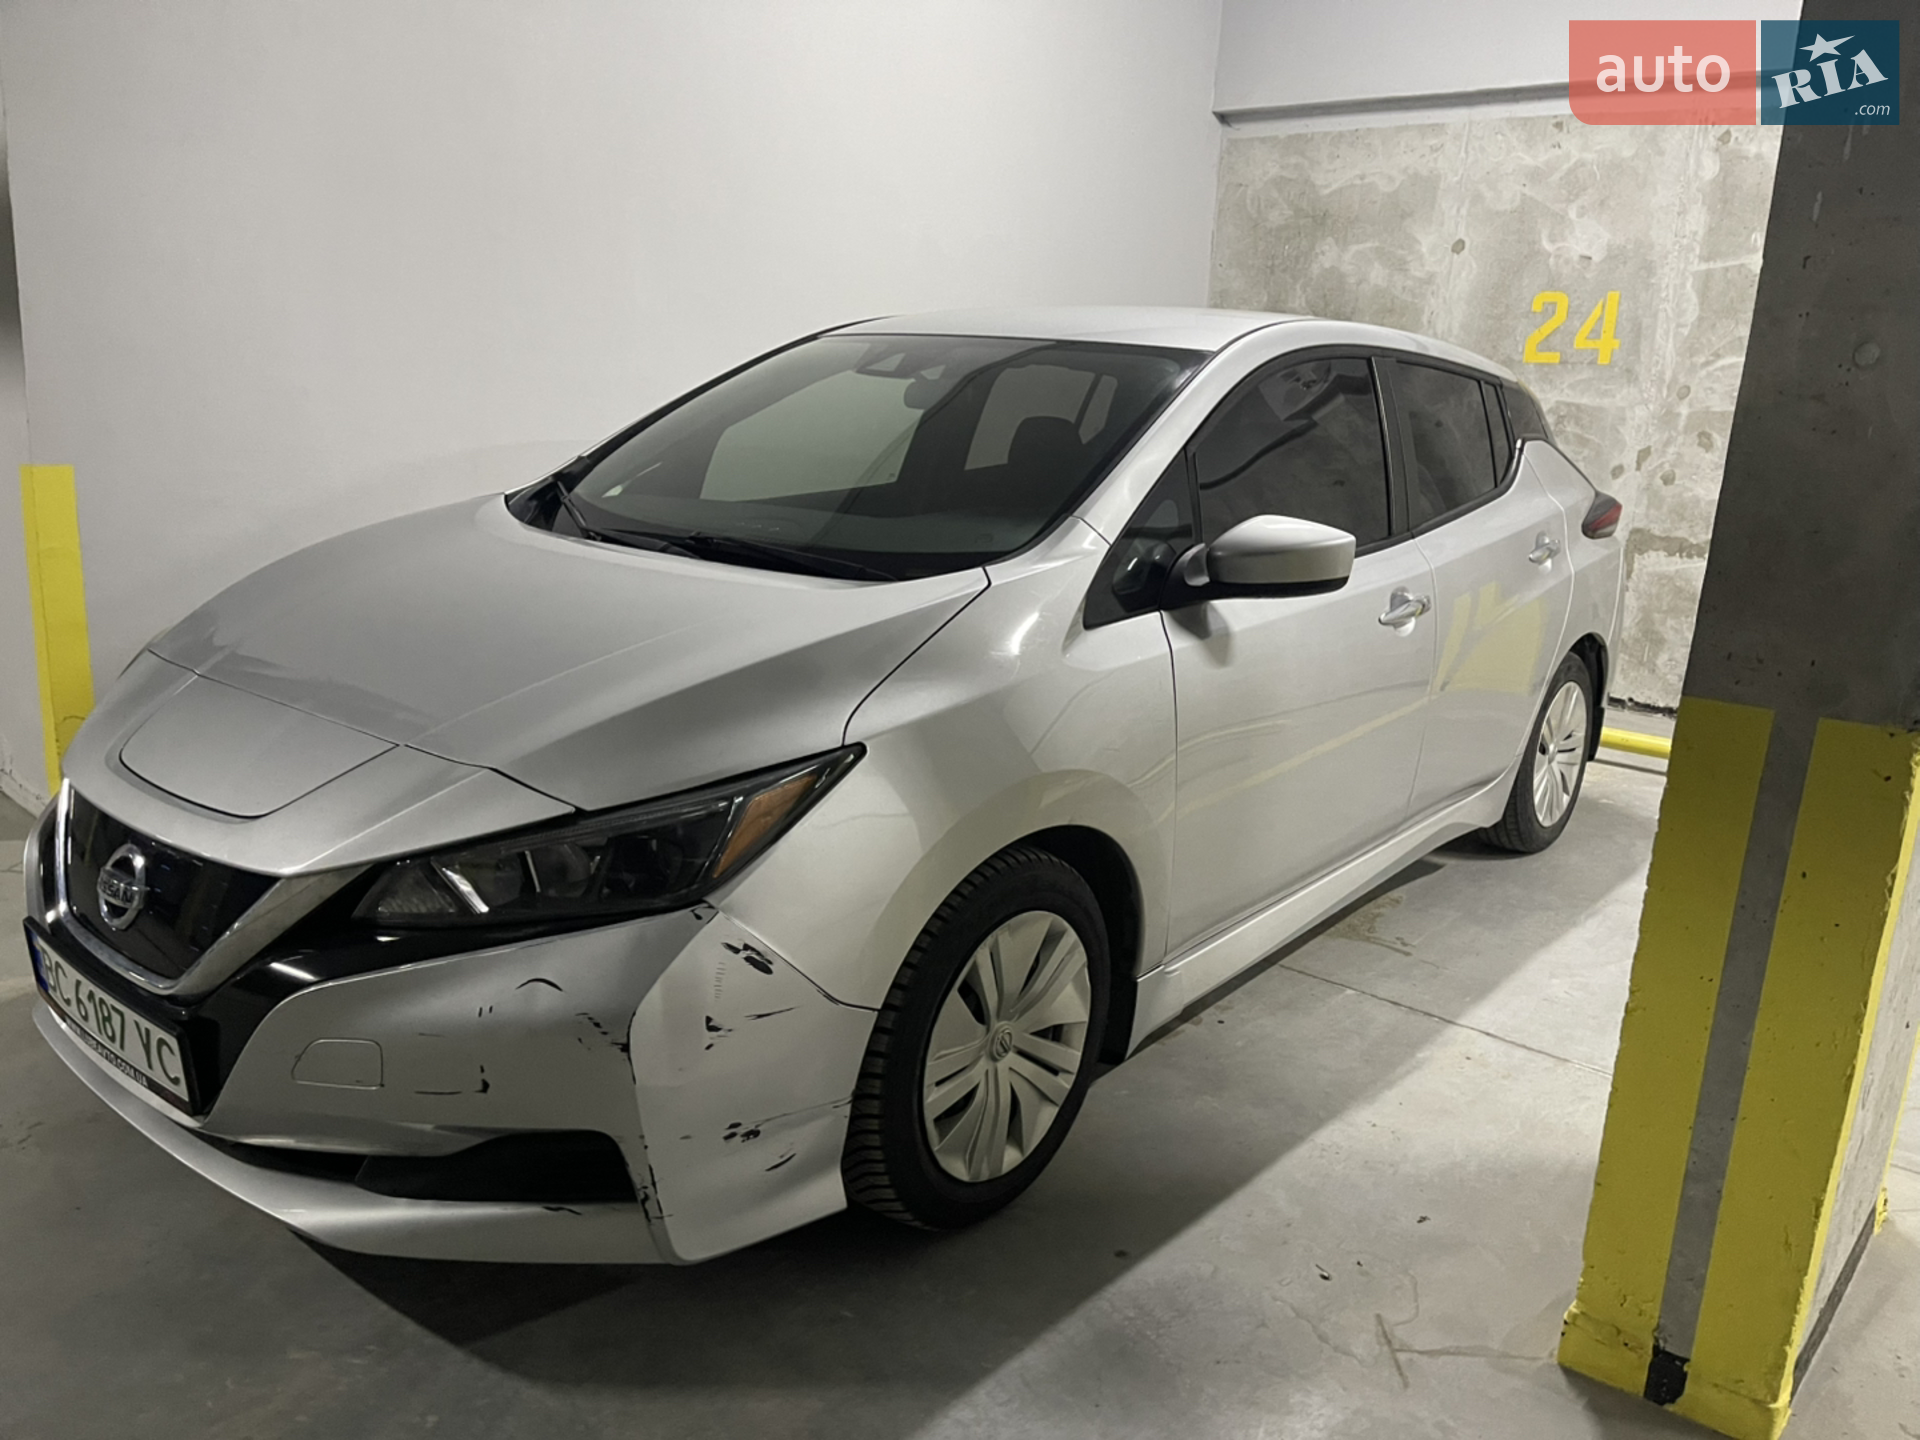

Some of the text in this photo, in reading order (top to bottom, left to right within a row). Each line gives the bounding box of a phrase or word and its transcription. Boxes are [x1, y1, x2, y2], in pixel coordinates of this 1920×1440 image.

[1523, 290, 1621, 365] 24
[40, 944, 72, 1007] BC
[75, 978, 125, 1052] 6187
[133, 1018, 181, 1086] YC
